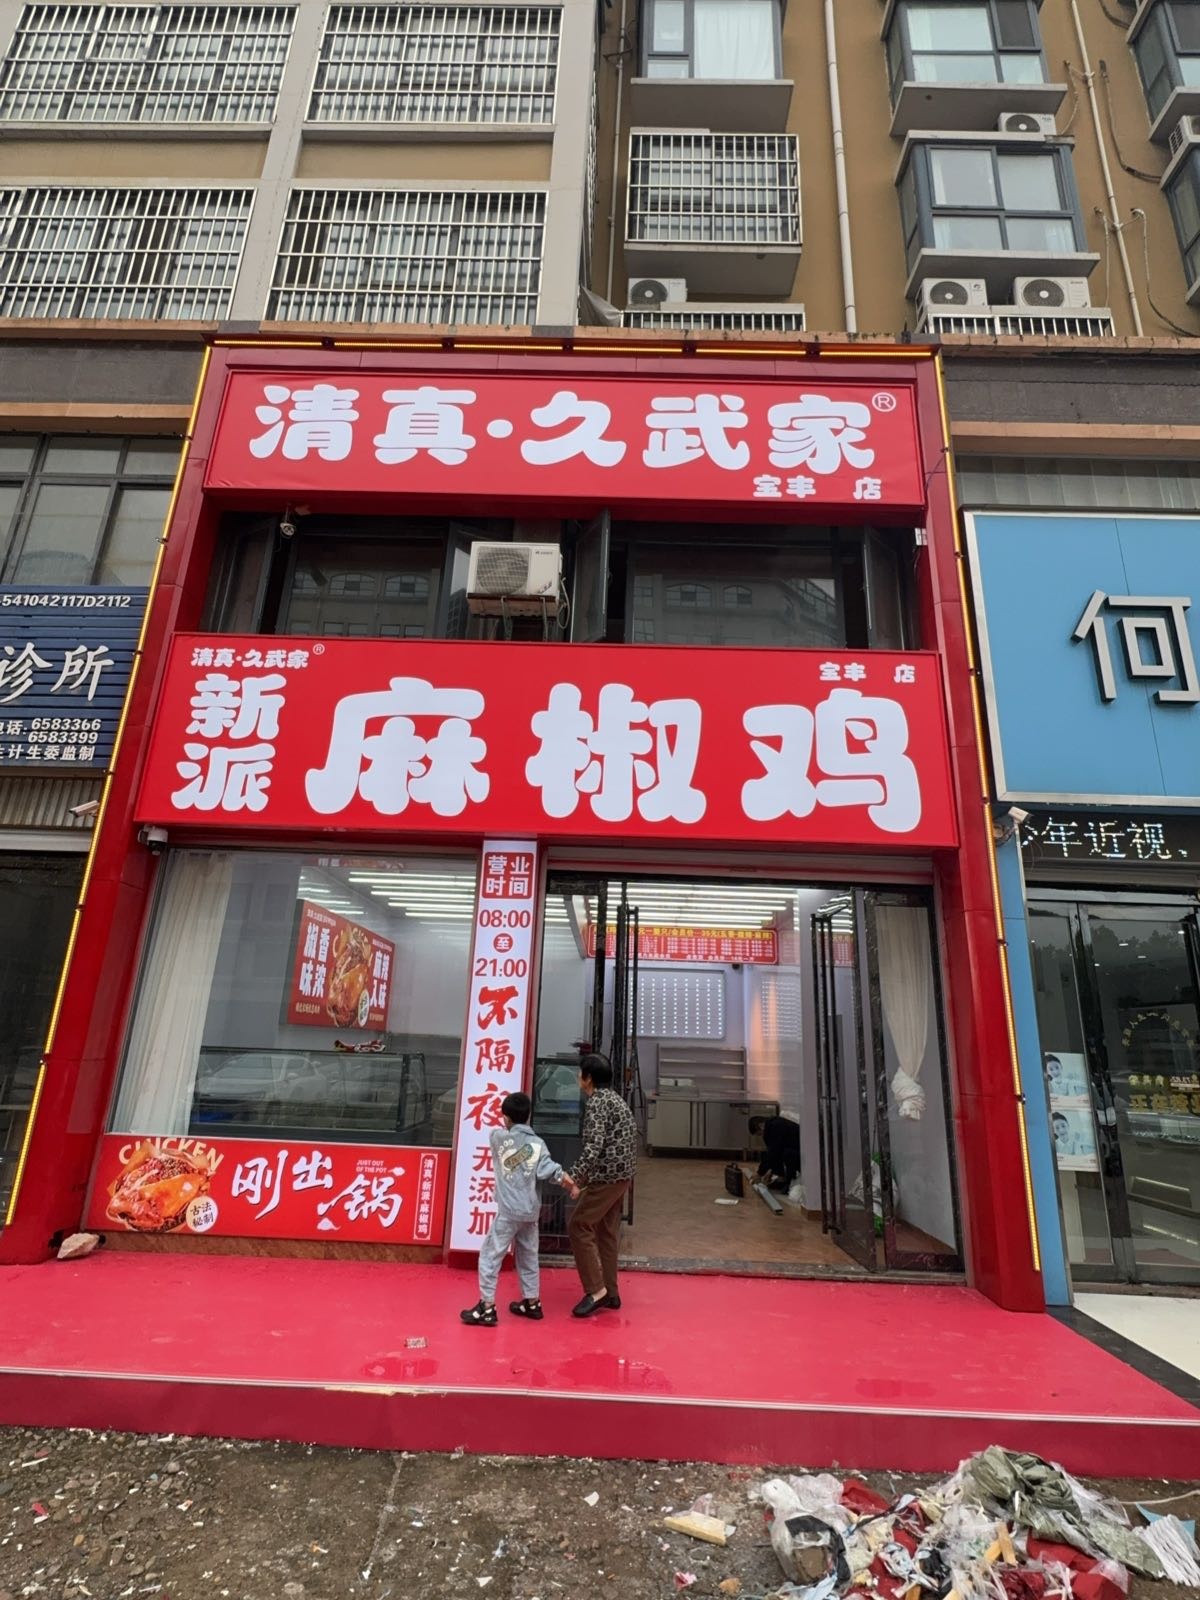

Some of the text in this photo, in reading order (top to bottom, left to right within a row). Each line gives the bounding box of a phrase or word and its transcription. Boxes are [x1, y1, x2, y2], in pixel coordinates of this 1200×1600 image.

[248, 383, 873, 475] 清真·久武家
[1070, 588, 1200, 705] 何
[190, 647, 310, 669] 清真·久武家
[0, 641, 116, 703] 诊所
[31, 718, 102, 731] 6583366
[27, 731, 99, 744] 6583399
[170, 673, 287, 812] 新派
[304, 676, 923, 834] 麻椒鸡
[487, 855, 531, 875] 营业
[485, 876, 529, 897] 时间
[479, 909, 532, 928] 08:00
[495, 936, 511, 950] 至
[474, 958, 528, 977] 21:00
[464, 985, 519, 1131] 不隔夜
[118, 1137, 225, 1172] CICKEN
[231, 1149, 403, 1228] 刚出锅
[190, 1202, 212, 1215] 古法
